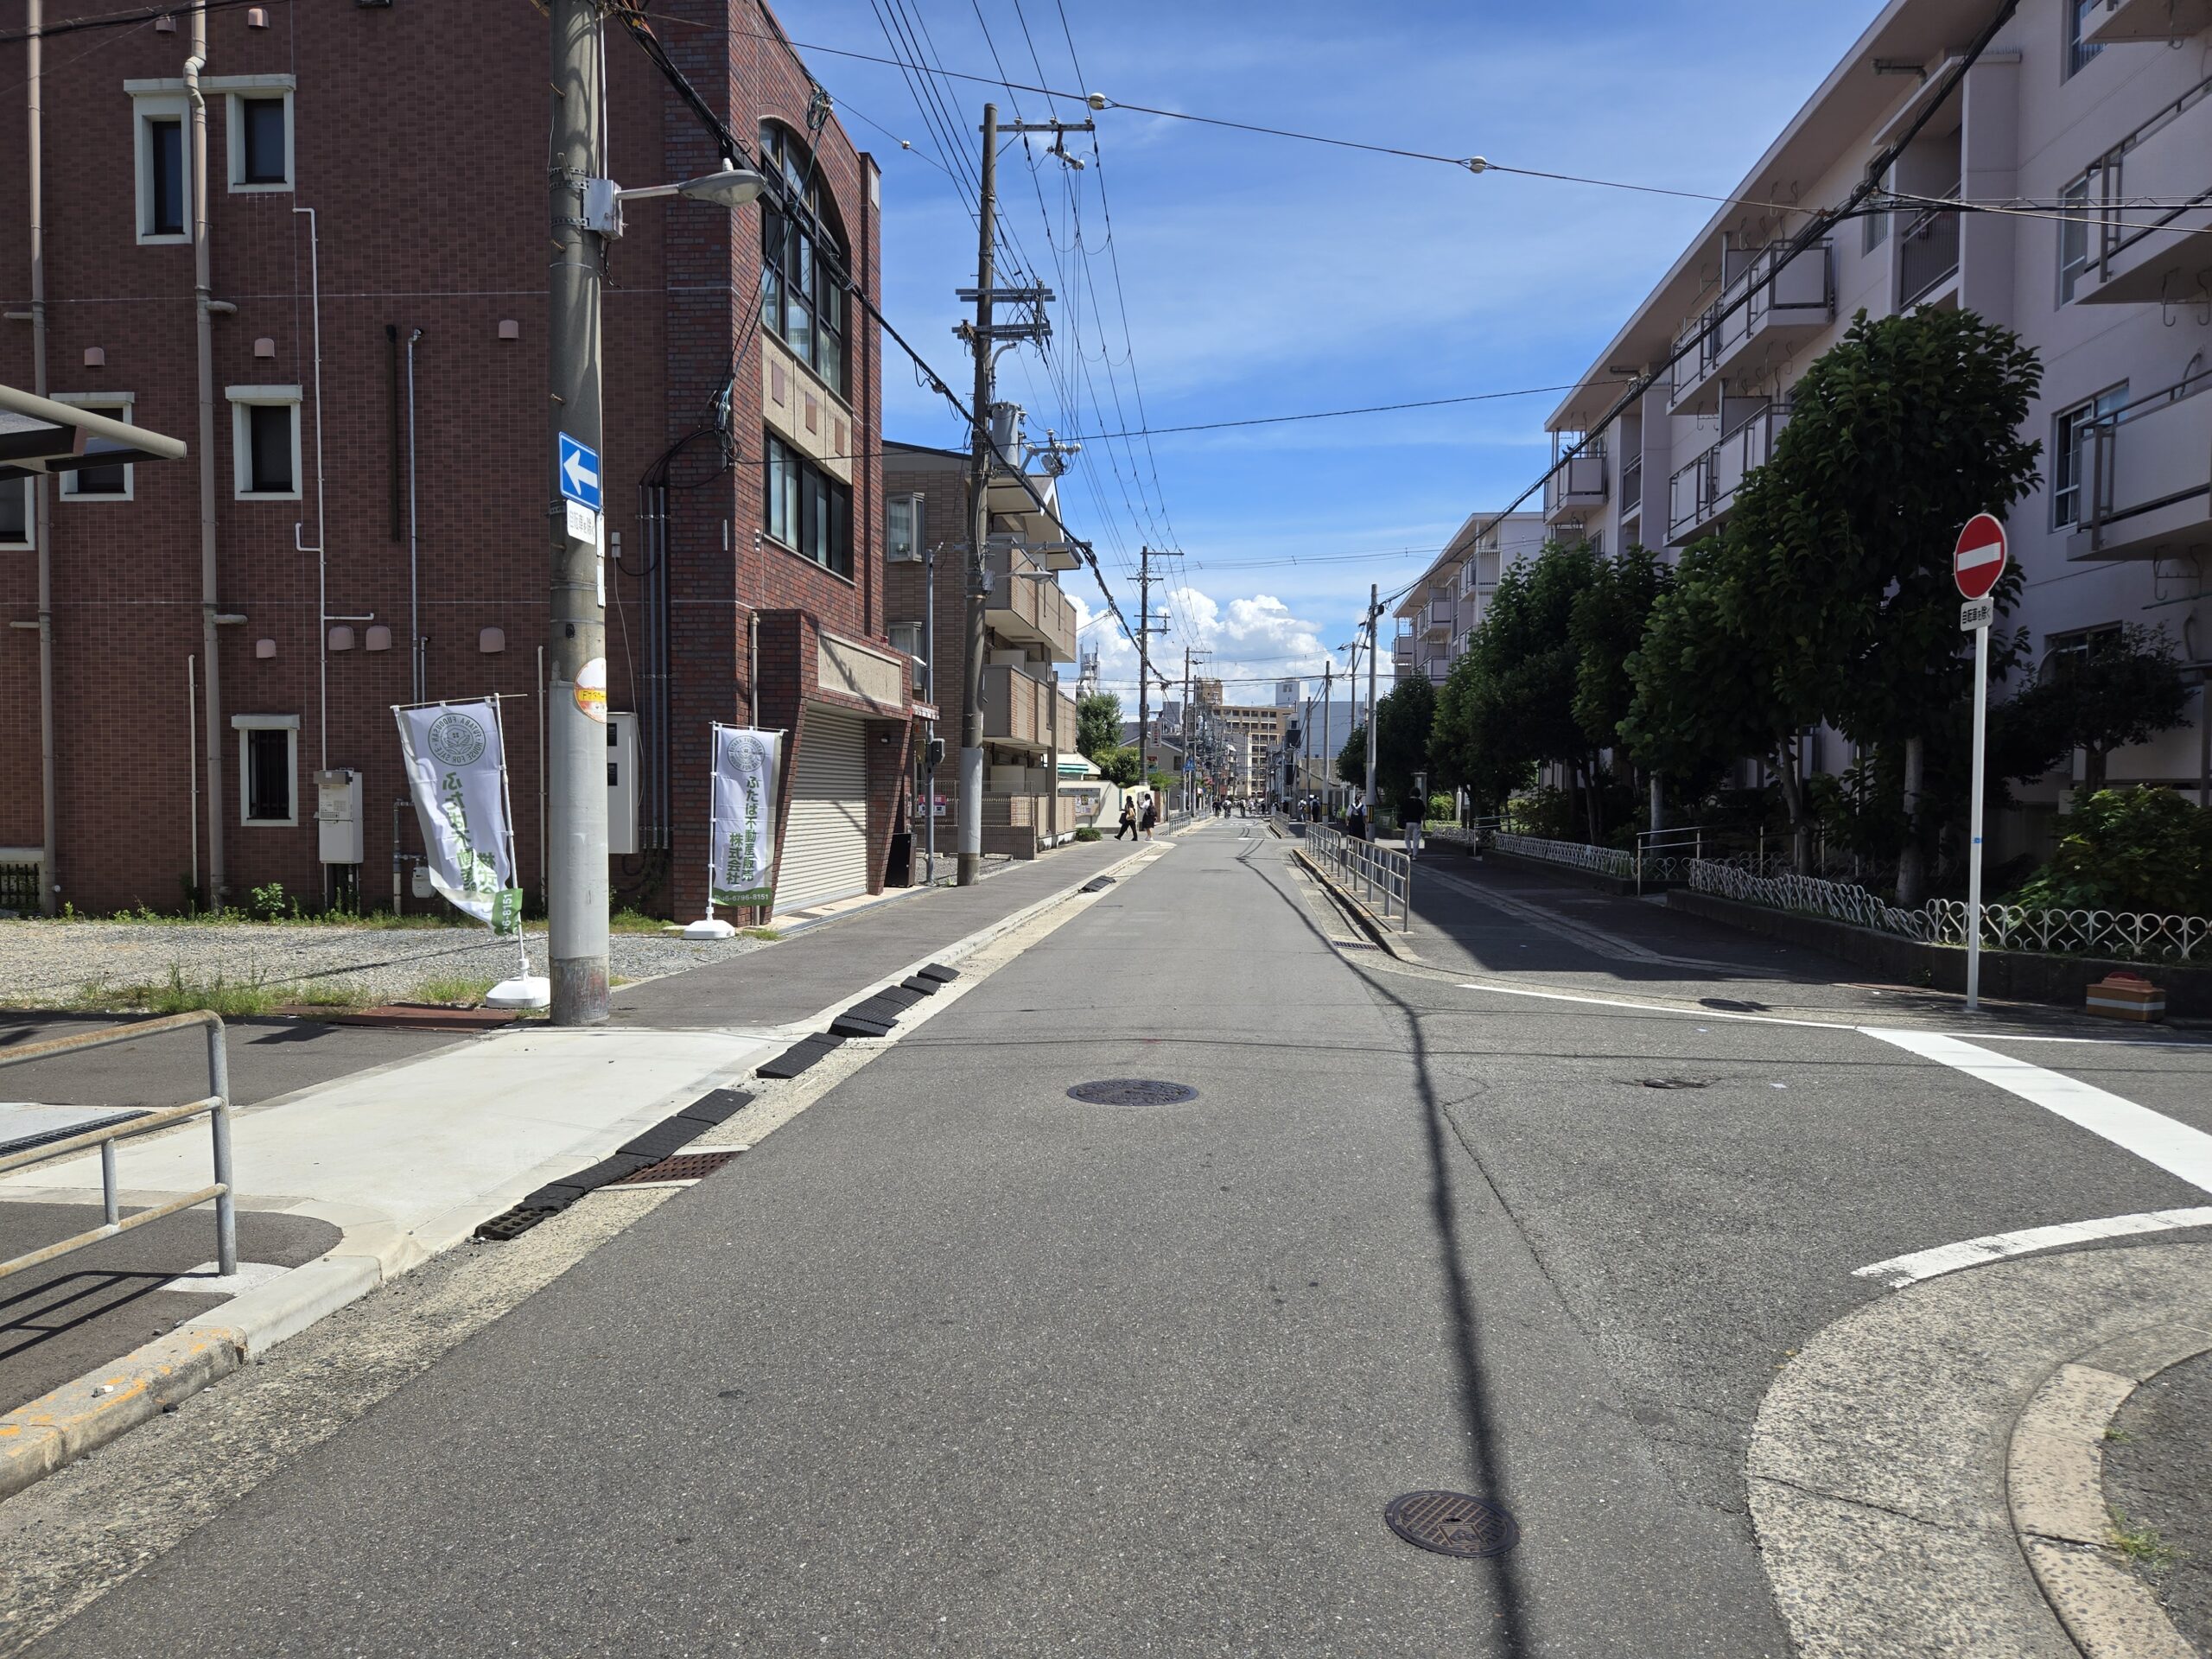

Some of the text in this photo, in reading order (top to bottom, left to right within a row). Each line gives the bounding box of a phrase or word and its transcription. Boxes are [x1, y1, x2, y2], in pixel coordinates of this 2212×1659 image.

[726, 832, 745, 885] 株式会社
[741, 776, 760, 881] ふたば不動産販売
